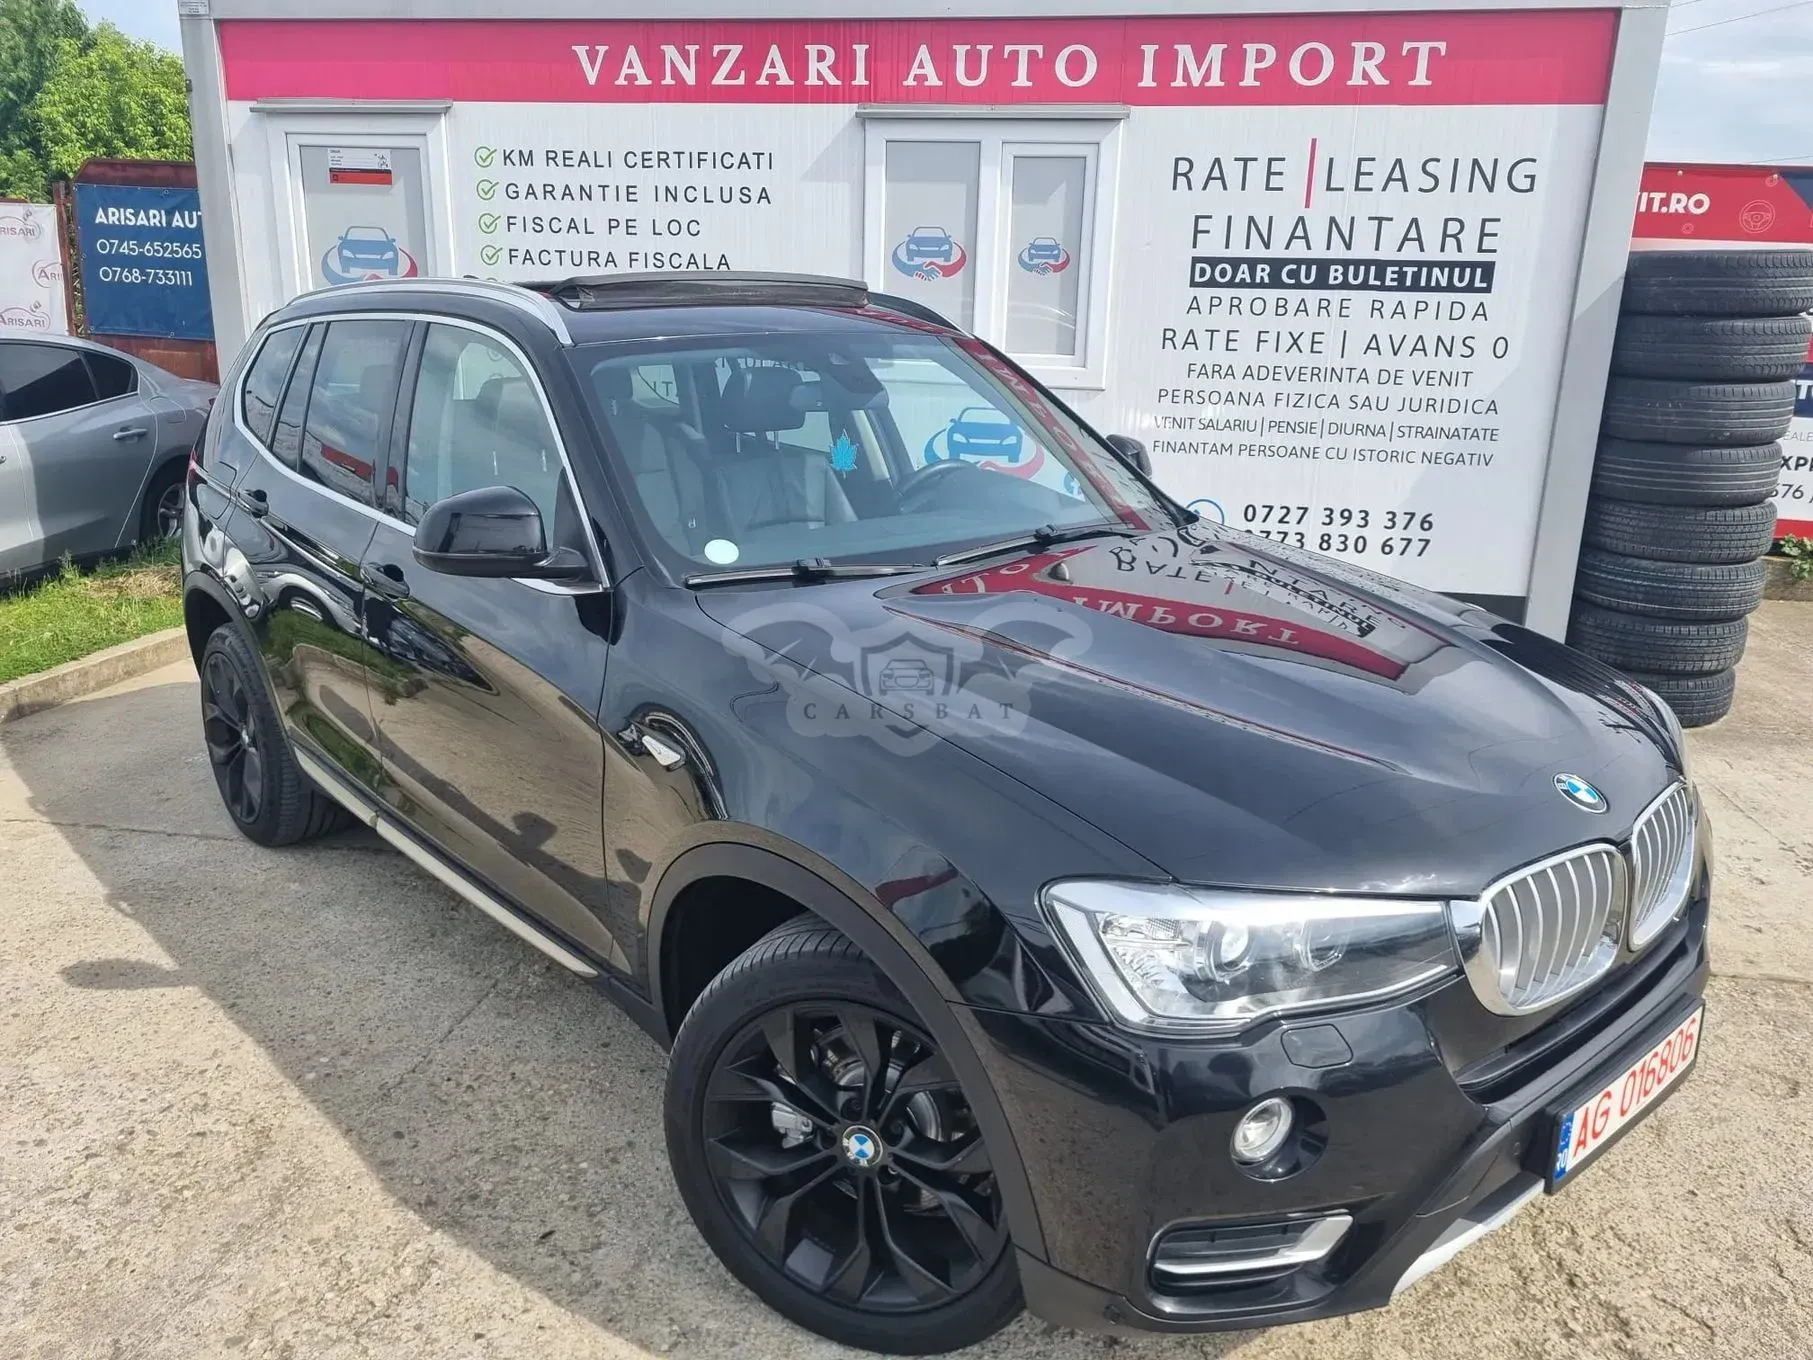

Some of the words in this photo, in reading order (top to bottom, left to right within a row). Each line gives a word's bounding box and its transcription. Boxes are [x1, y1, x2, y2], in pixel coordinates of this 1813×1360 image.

[571, 43, 870, 86] VANZARI
[902, 43, 1098, 87] AUTO
[1137, 41, 1447, 87] IMPORT
[502, 149, 534, 167] KM
[545, 150, 613, 168] REALI
[623, 151, 774, 170] CERTIFICATI
[1172, 156, 1286, 192] RATE
[1325, 156, 1538, 193] LEASING
[505, 183, 638, 202] GARANTIE
[654, 185, 772, 205] INCLUSA
[1637, 191, 1711, 215] IT.RO
[95, 207, 167, 228] ARISARI
[171, 210, 202, 229] AU
[506, 215, 595, 235] FISCAL
[608, 218, 638, 236] PE
[652, 219, 702, 237] LOC
[1191, 214, 1501, 254] FINANTARE
[97, 239, 202, 259] 0745-652565
[508, 248, 618, 268] FACTURA
[628, 252, 731, 271] FISCALA
[99, 266, 193, 286] 0768-733111
[1193, 262, 1271, 285] DOAR
[1281, 263, 1317, 285] CU
[1328, 264, 1488, 288] BULETINUL
[1186, 295, 1353, 318] APROBARE
[1369, 298, 1489, 322] RAPIDA
[1161, 328, 1240, 352] RATE
[1256, 330, 1326, 355] FIXE
[1363, 334, 1477, 359] AVANS
[1492, 336, 1510, 360] 0
[1187, 363, 1239, 381] FARA
[1242, 364, 1370, 385] ADEVERINTA
[1377, 368, 1405, 386] DE
[1411, 370, 1474, 388] VENIT
[1158, 388, 1266, 408] PERSOANA
[1274, 392, 1341, 410] FIZICA
[1348, 394, 1390, 412] SAU
[1396, 396, 1500, 415] JURIDICA
[1154, 415, 1196, 430] VENIT
[1198, 417, 1258, 433] SALARIU
[1268, 420, 1318, 436] PENSIE
[1327, 421, 1387, 438] DIURNA
[1396, 424, 1500, 442] STRAINATATE
[1152, 440, 1234, 456] FINANTAM
[1238, 443, 1321, 460] PERSOANE
[1325, 446, 1348, 462] CU
[1353, 448, 1416, 465] ISTORIC
[1420, 450, 1495, 467] NEGATIV
[1243, 504, 1310, 525] 0727
[1321, 508, 1371, 529] 393
[1383, 511, 1435, 532] 376
[1245, 529, 1306, 549] 773
[1318, 534, 1368, 554] 830
[1380, 537, 1433, 557] 677
[1573, 1090, 1613, 1157] AG
[1619, 1017, 1697, 1118] 016806
